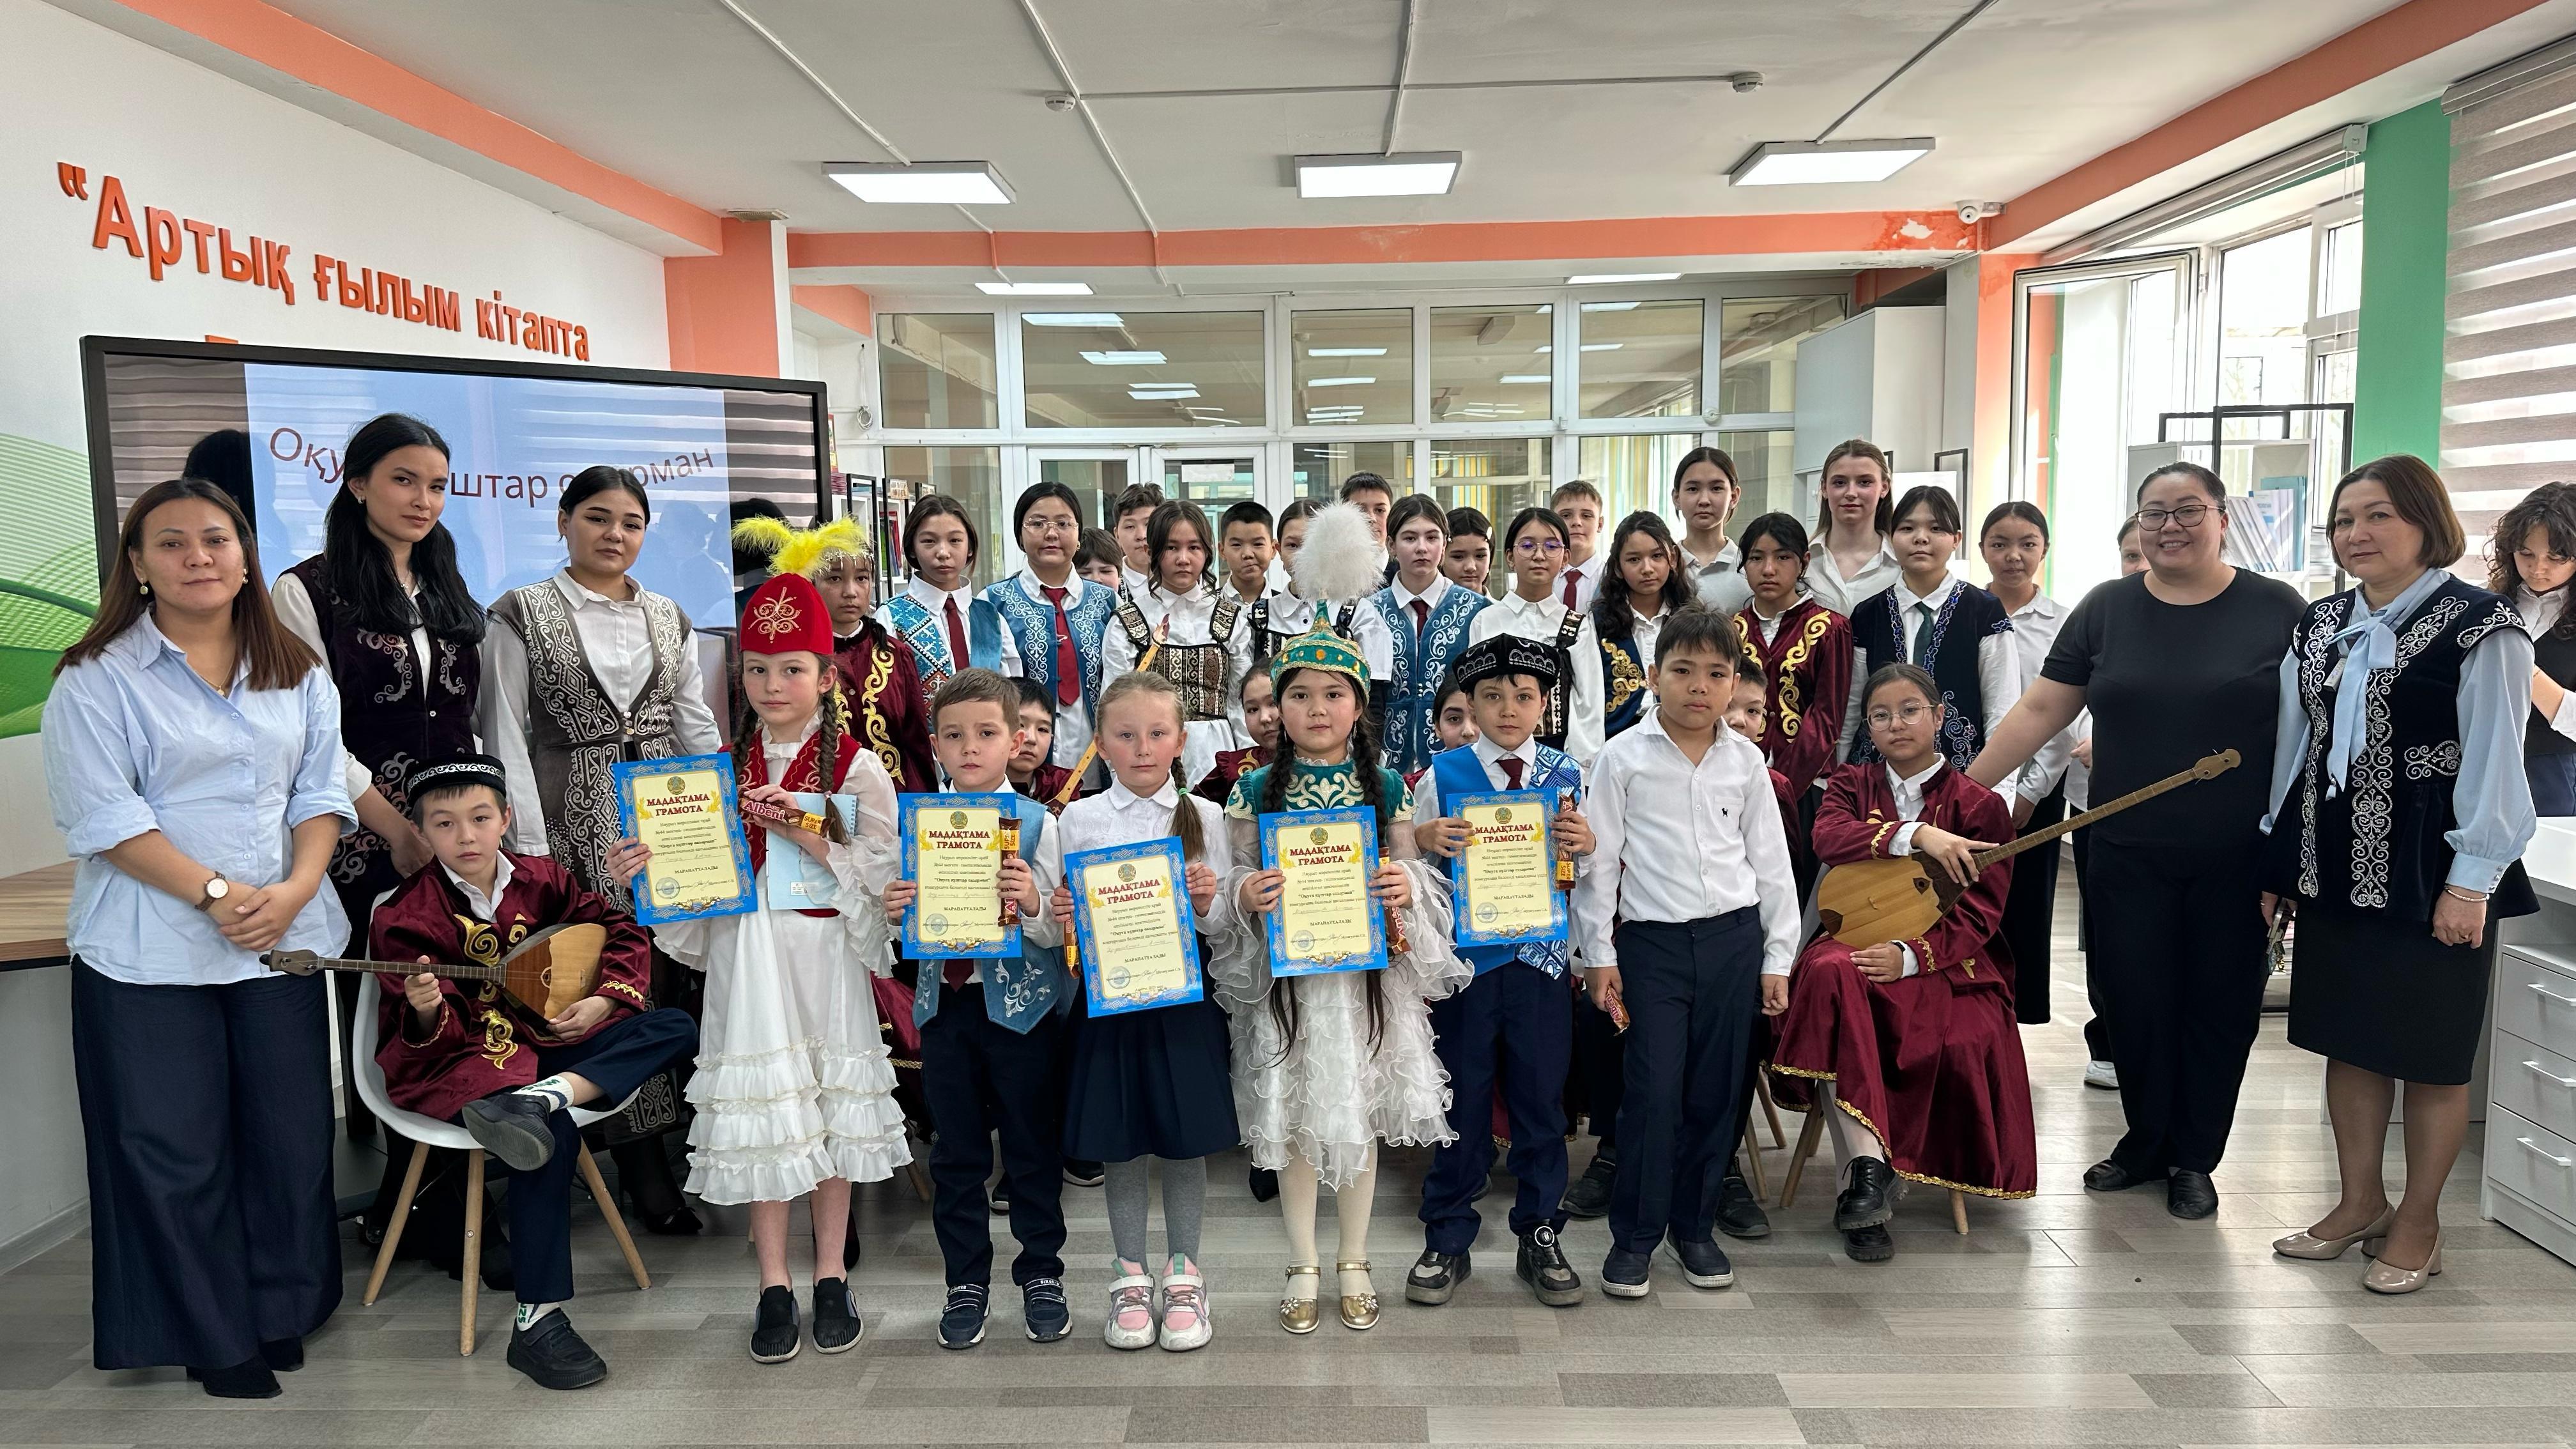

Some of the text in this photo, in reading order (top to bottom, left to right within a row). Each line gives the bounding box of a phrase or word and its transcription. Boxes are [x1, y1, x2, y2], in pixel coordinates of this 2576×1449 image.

[313, 254, 461, 332] ғылым
[476, 290, 590, 362] кітапта
[270, 427, 345, 484] Оқу
[451, 472, 548, 508] штар
[647, 793, 710, 808] МАДАҚТАМА
[656, 805, 703, 816] ГРАМОТА
[743, 801, 785, 820] Albeni
[804, 816, 821, 824] SUPER
[1475, 824, 1534, 834] МАДАҚТАМА
[929, 831, 990, 839] МАДАҚТАМА
[1483, 834, 1528, 843] ГРАМОТА
[1289, 845, 1352, 856] МАДАҚТАМА
[1298, 855, 1345, 866] ГРАМОТА
[1098, 879, 1161, 895] МАДАҚТАМА
[1107, 891, 1154, 905] ГРАМОТА
